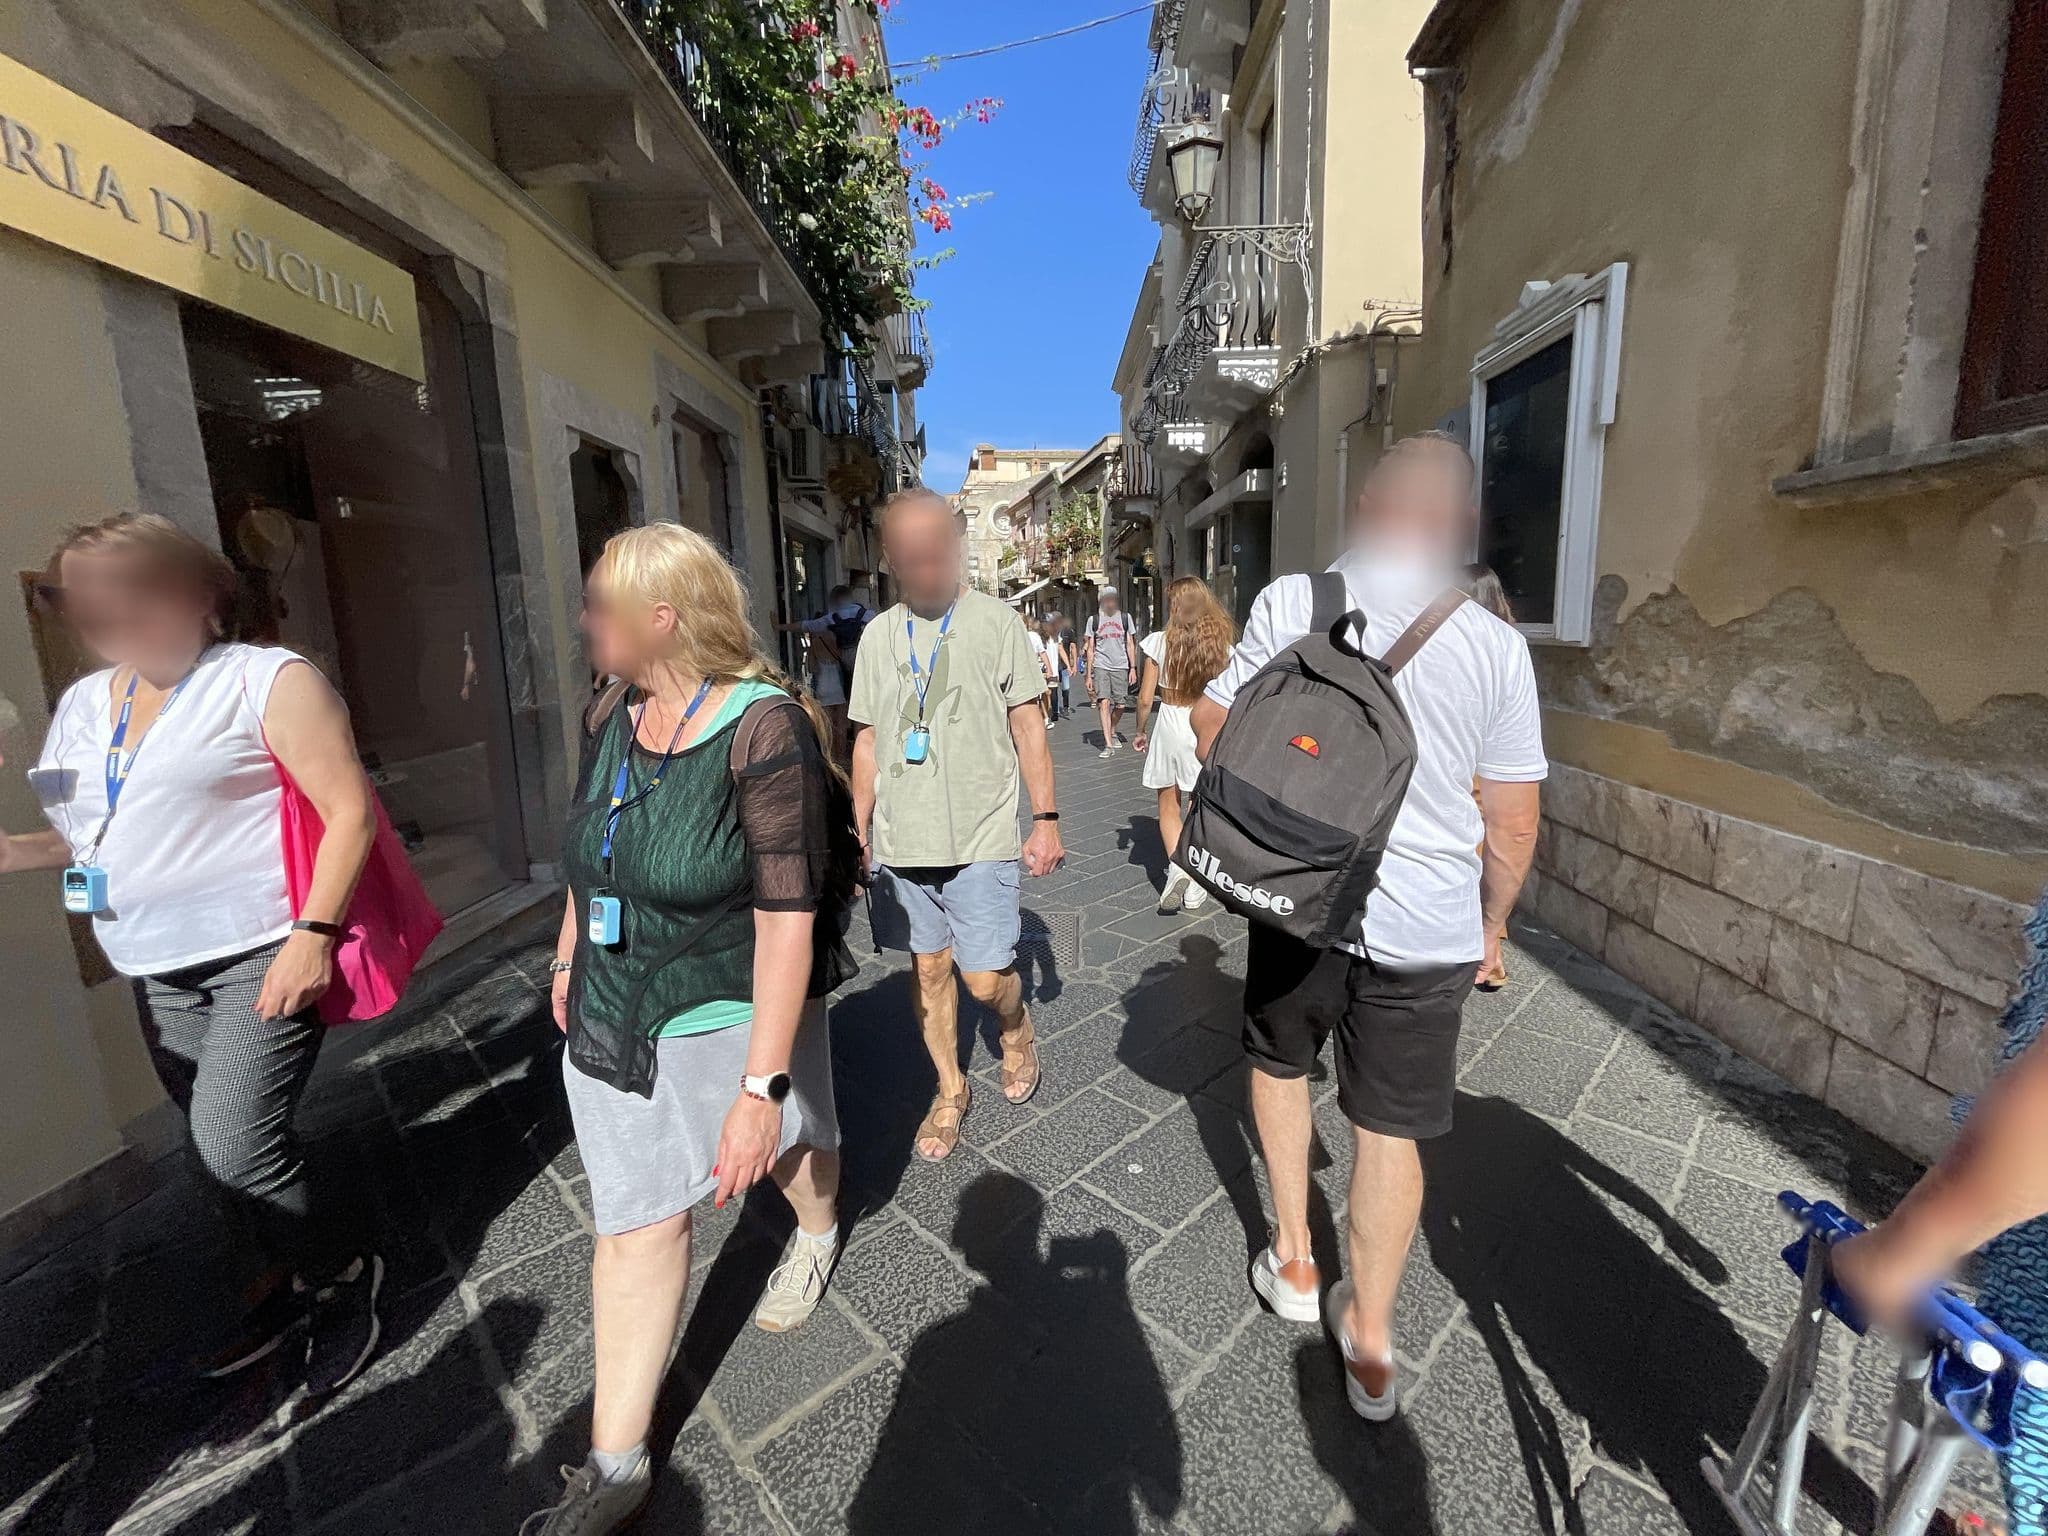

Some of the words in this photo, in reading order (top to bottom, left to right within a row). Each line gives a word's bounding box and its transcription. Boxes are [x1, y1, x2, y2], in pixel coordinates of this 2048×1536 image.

[0, 114, 140, 224] RIA
[149, 187, 221, 260] DI
[233, 228, 394, 335] SICILIA
[1188, 845, 1295, 916] ellesse
